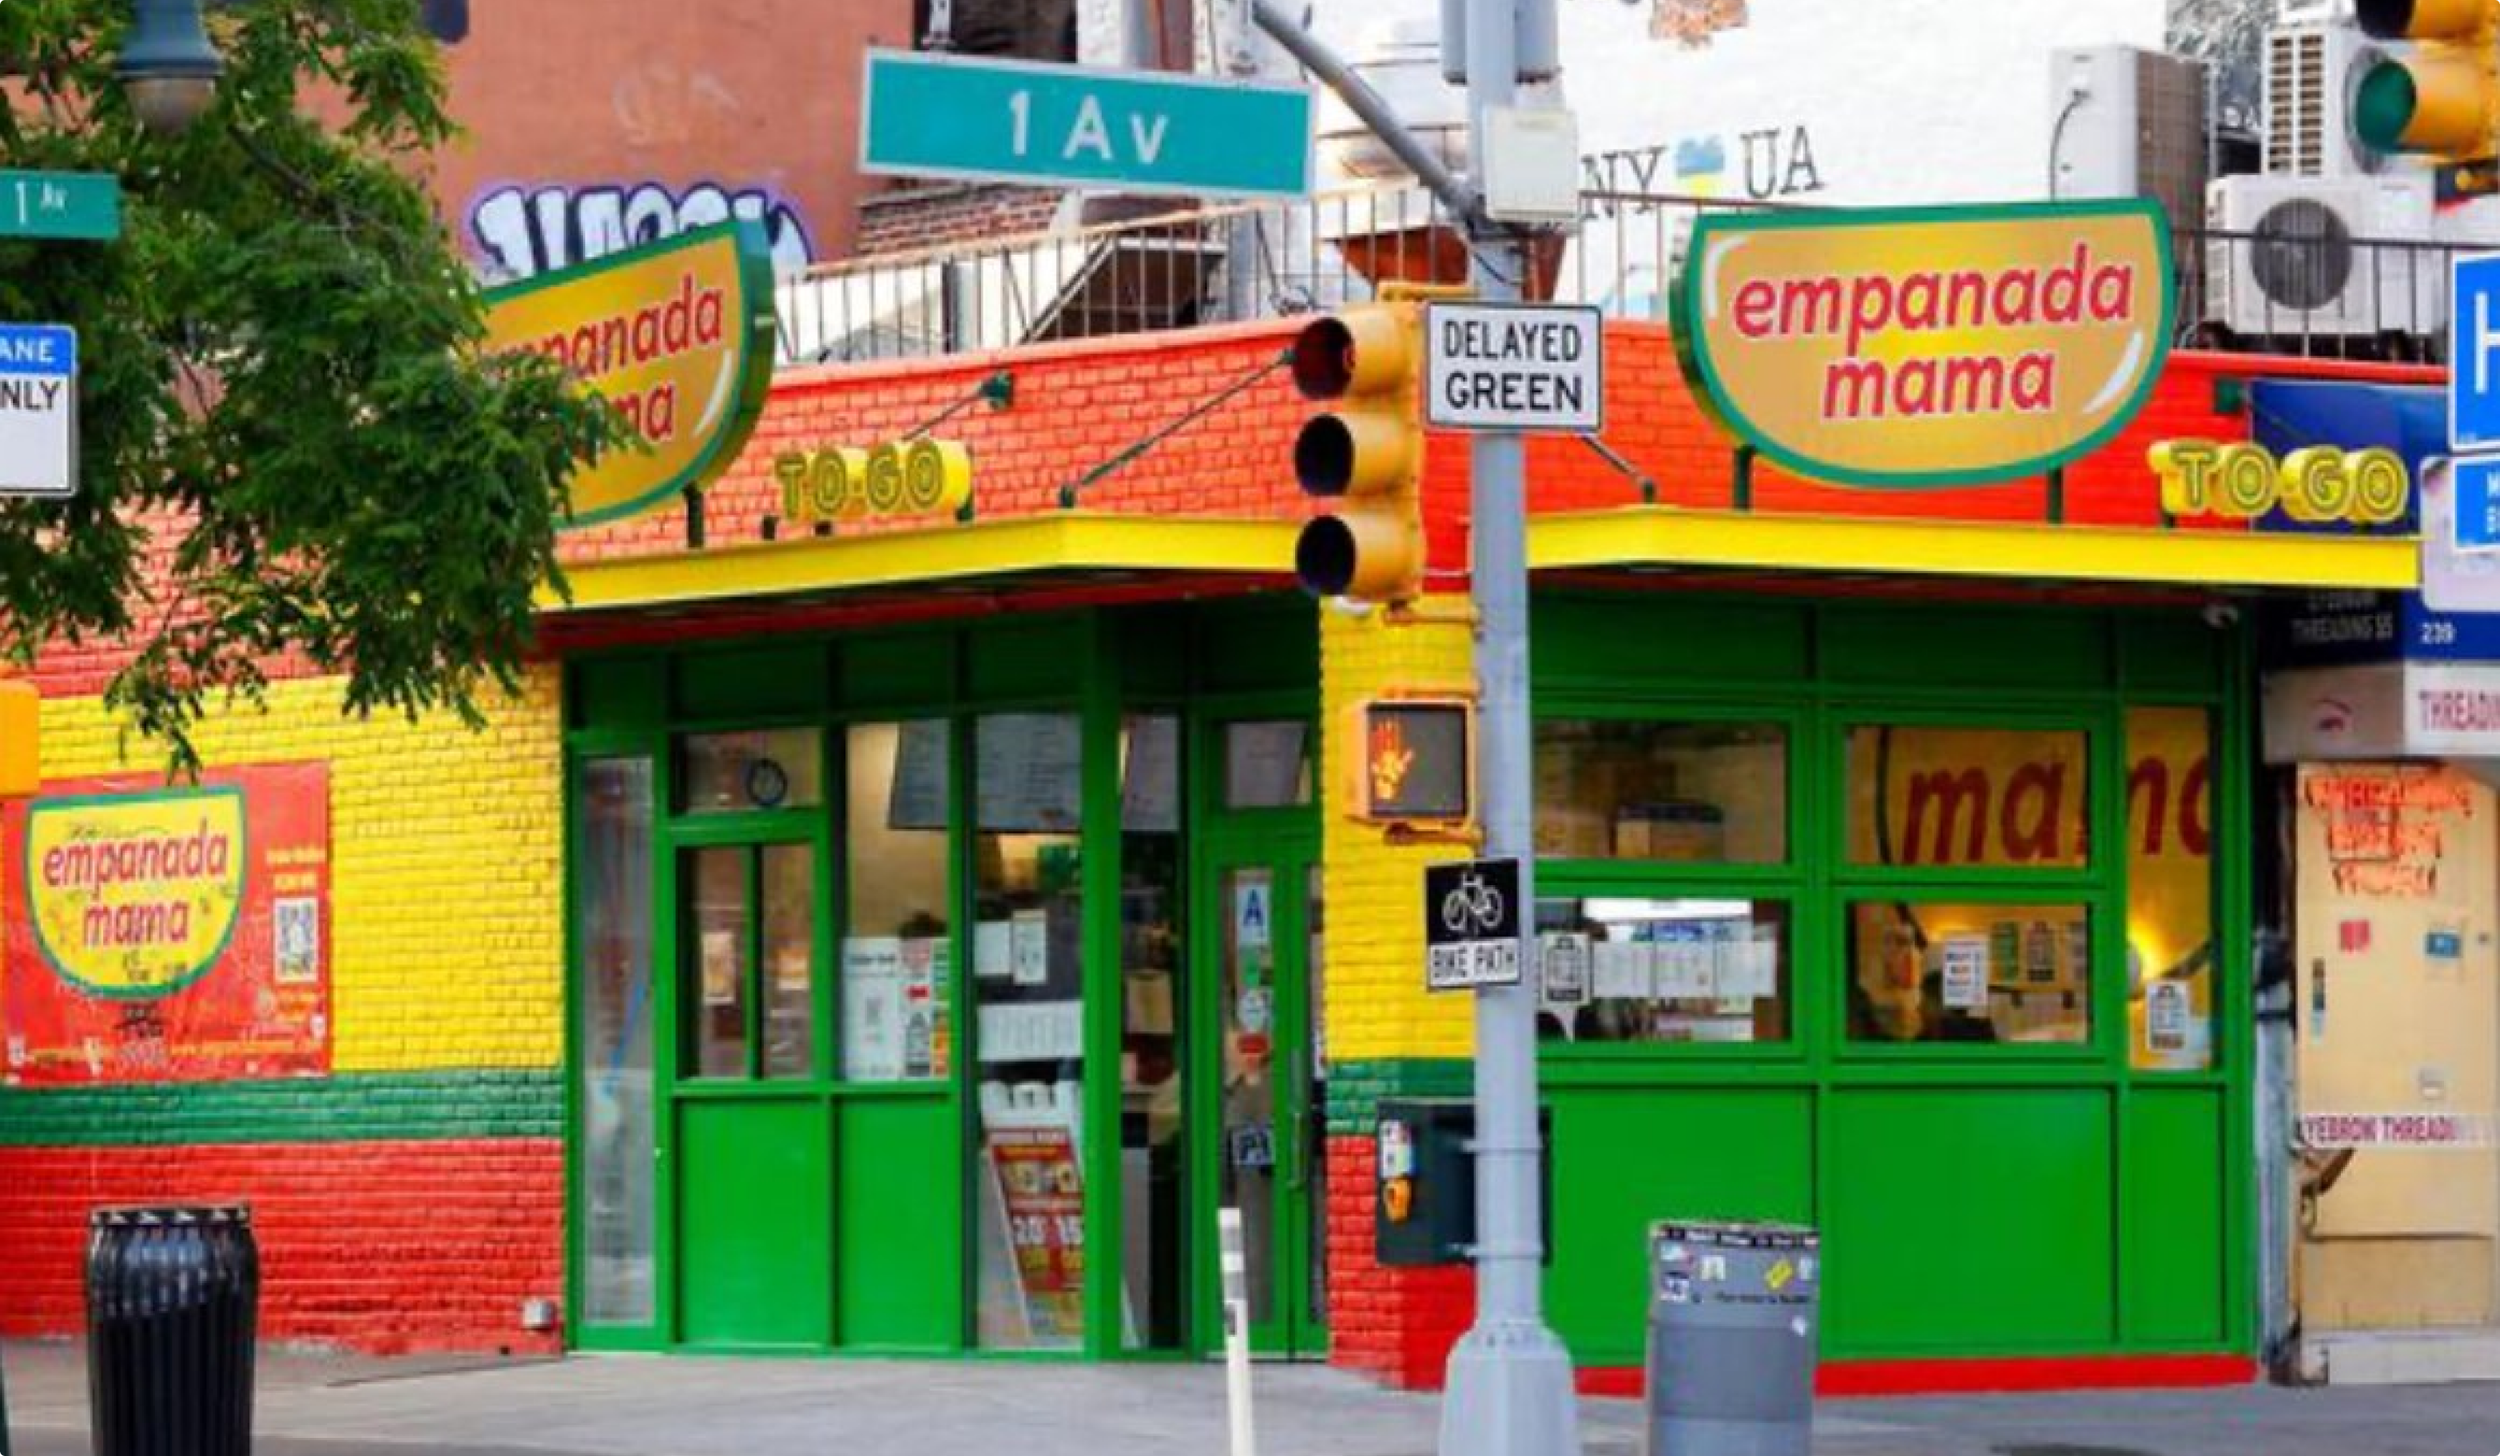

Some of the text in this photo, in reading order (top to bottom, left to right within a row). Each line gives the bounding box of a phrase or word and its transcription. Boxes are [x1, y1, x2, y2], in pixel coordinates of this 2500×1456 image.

[1008, 91, 1168, 165] 1 Av
[1579, 124, 1826, 222] NY UA
[15, 180, 27, 226] 1
[1732, 242, 2133, 358] empanada
[1444, 320, 1582, 362] DELAYED
[1445, 371, 1582, 413] GREEN
[1822, 351, 2055, 418] mama
[43, 817, 229, 900] empanada
[83, 900, 191, 947] mama
[1243, 888, 1264, 927] A
[1434, 945, 1468, 979] BIKE
[1475, 943, 1516, 976] PATH
